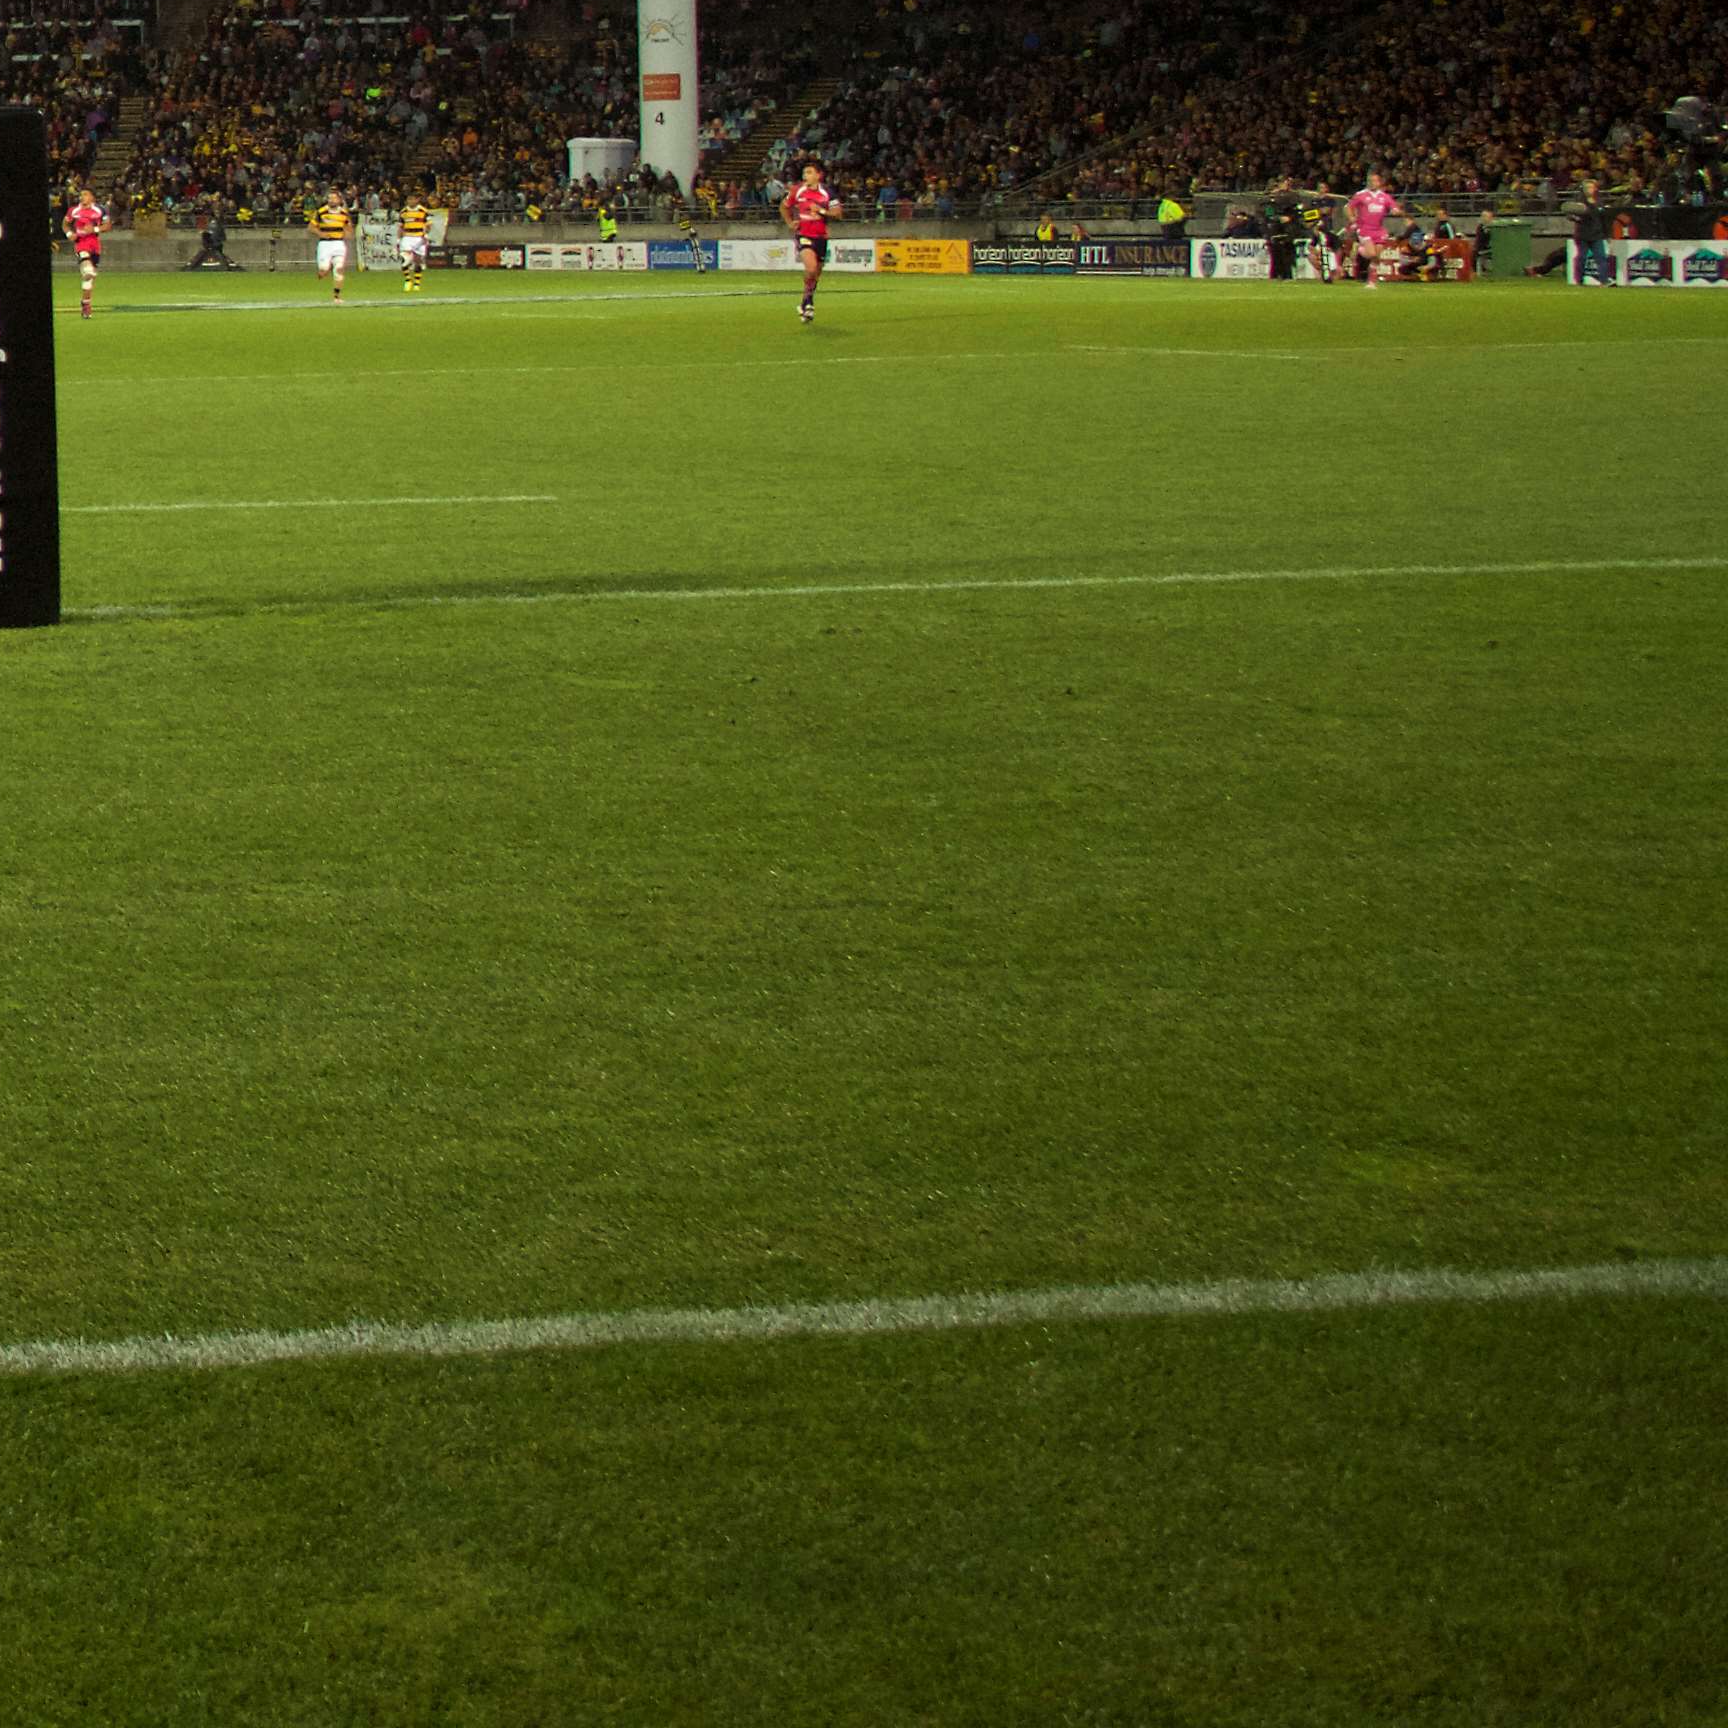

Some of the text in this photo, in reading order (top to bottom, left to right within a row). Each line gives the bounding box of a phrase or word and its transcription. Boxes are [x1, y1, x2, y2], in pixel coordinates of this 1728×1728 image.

[655, 112, 665, 126] 4
[1080, 245, 1186, 264] HTL INSURANCE
